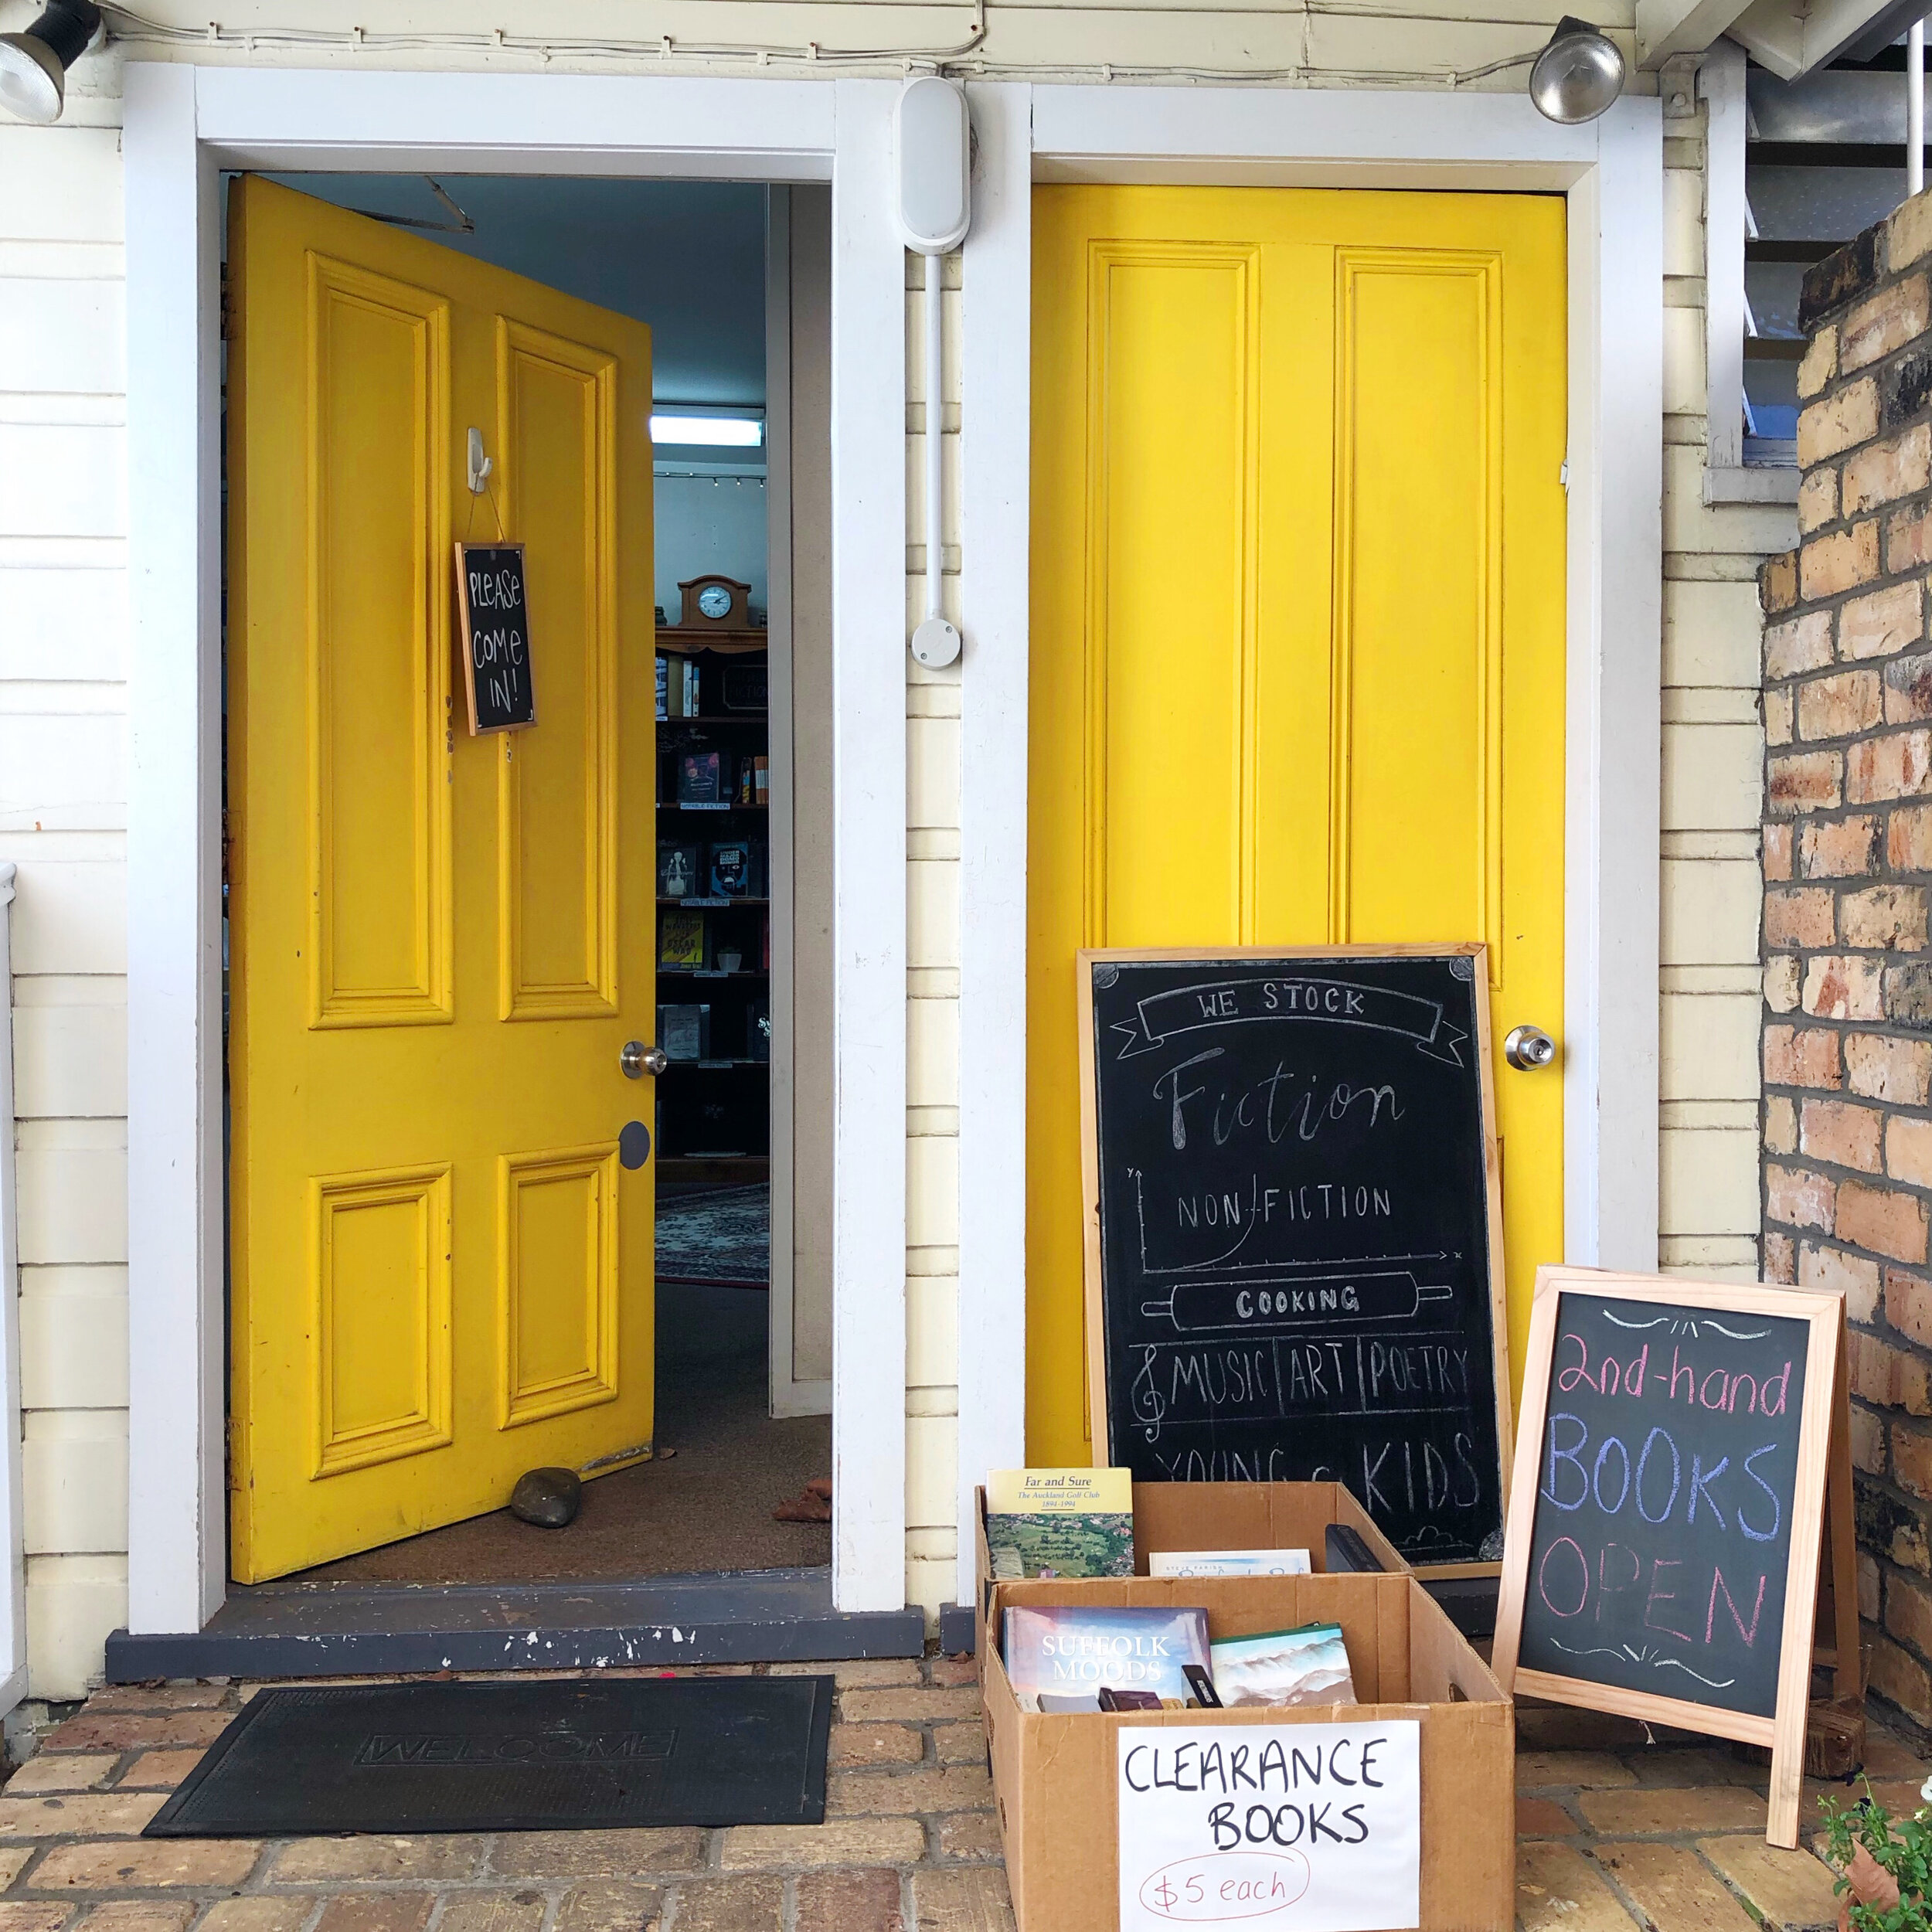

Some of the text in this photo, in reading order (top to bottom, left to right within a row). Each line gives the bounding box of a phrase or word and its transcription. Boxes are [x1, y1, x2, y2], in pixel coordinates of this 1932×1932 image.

[489, 668, 519, 713] IN!
[1196, 982, 1366, 1018] WE STOCK
[1152, 1046, 1405, 1151] Fiction
[1177, 1184, 1392, 1228] NON-FICTION
[1236, 1284, 1360, 1318] COOKING
[1171, 1341, 1468, 1405] MUSIC ART POETRY
[1557, 1333, 1791, 1417] 2nd-hand
[1025, 1475, 1092, 1486] Far and Sure
[1363, 1432, 1480, 1513] KIDS
[1540, 1413, 1781, 1542] BOOKS
[1539, 1536, 1767, 1648] OPEN
[1042, 1636, 1171, 1657] SUFFOLK
[1053, 1660, 1163, 1682] MOODS
[369, 1733, 671, 1761] WELCOME
[1124, 1738, 1388, 1794] CLEARANCE
[1208, 1801, 1369, 1851] BOOKS
[1219, 1871, 1286, 1901] each
